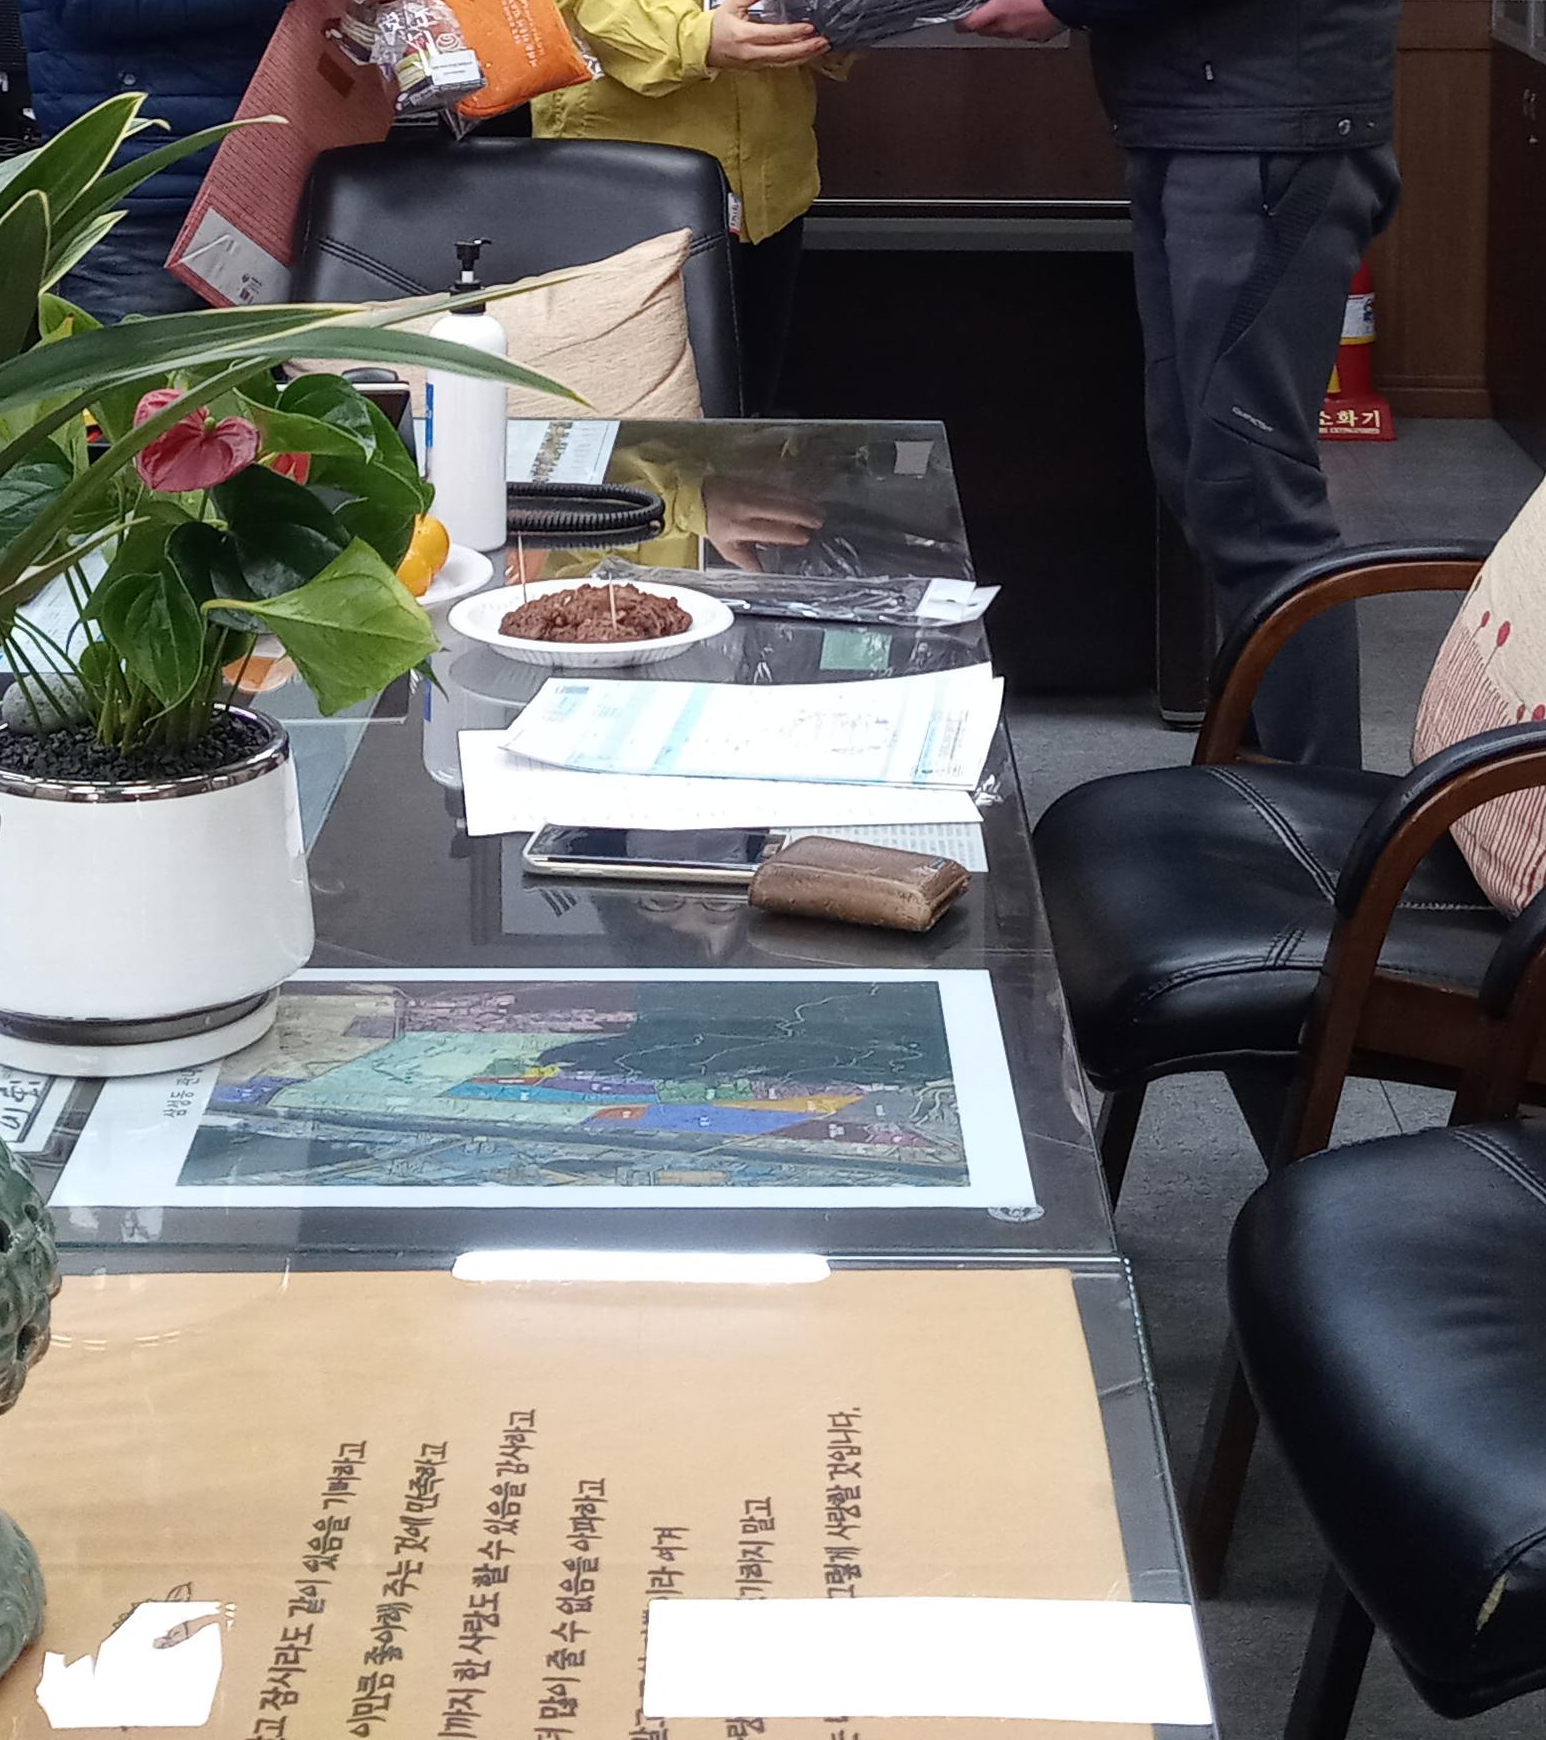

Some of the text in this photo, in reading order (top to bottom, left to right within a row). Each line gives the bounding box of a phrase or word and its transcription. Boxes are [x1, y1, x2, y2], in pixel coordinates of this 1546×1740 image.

[494, 1408, 538, 1478] 감사하고
[826, 1407, 863, 1481] 것입니다.
[320, 1439, 368, 1510] 기뻐하고
[482, 1480, 528, 1536] 있음을
[565, 1477, 609, 1553] 아파하고
[738, 1495, 776, 1535] 말고
[824, 1484, 863, 1542] 사랑할
[302, 1514, 351, 1573] 있음을
[476, 1538, 516, 1561] 수
[650, 1525, 692, 1562] 여겨
[735, 1539, 776, 1600] 기하지
[287, 1578, 333, 1619] 같이
[345, 1440, 450, 1739] 이만큼 좋아해 주는 것에 만족하고
[471, 1562, 511, 1588] 할
[554, 1555, 601, 1617] 없음을
[457, 1591, 500, 1656] 사랑도
[549, 1619, 593, 1644] 수
[258, 1623, 315, 1711] 잠시라도
[451, 1658, 493, 1683] 한
[545, 1647, 587, 1671] 줄
[537, 1676, 583, 1721] 많이
